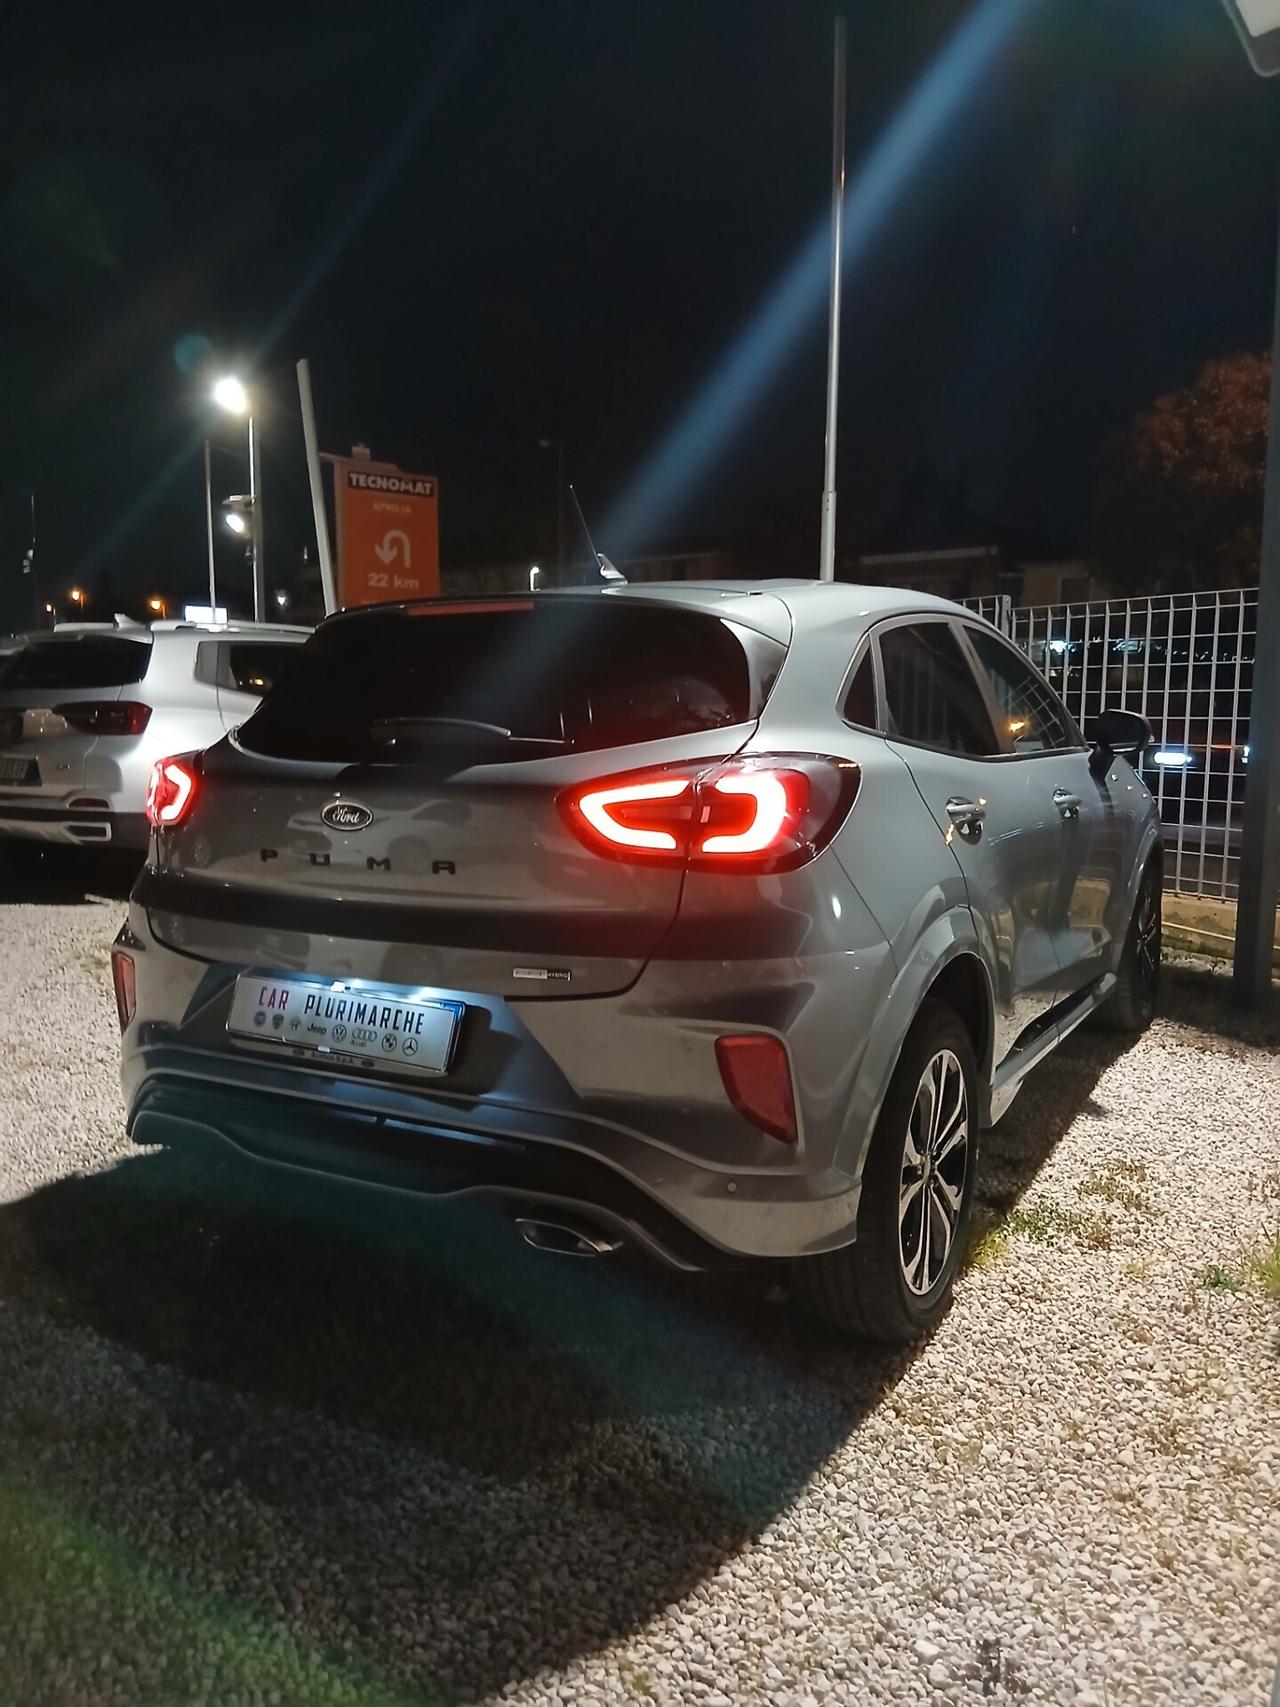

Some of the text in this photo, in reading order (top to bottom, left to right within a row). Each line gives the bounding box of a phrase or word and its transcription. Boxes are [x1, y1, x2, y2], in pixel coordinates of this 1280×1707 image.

[350, 473, 432, 494] TECNOMAT
[368, 573, 419, 589] 22 km
[332, 806, 360, 824] Ford
[260, 849, 456, 875] PUMA
[258, 986, 425, 1035] CAR PLURIMARCHE
